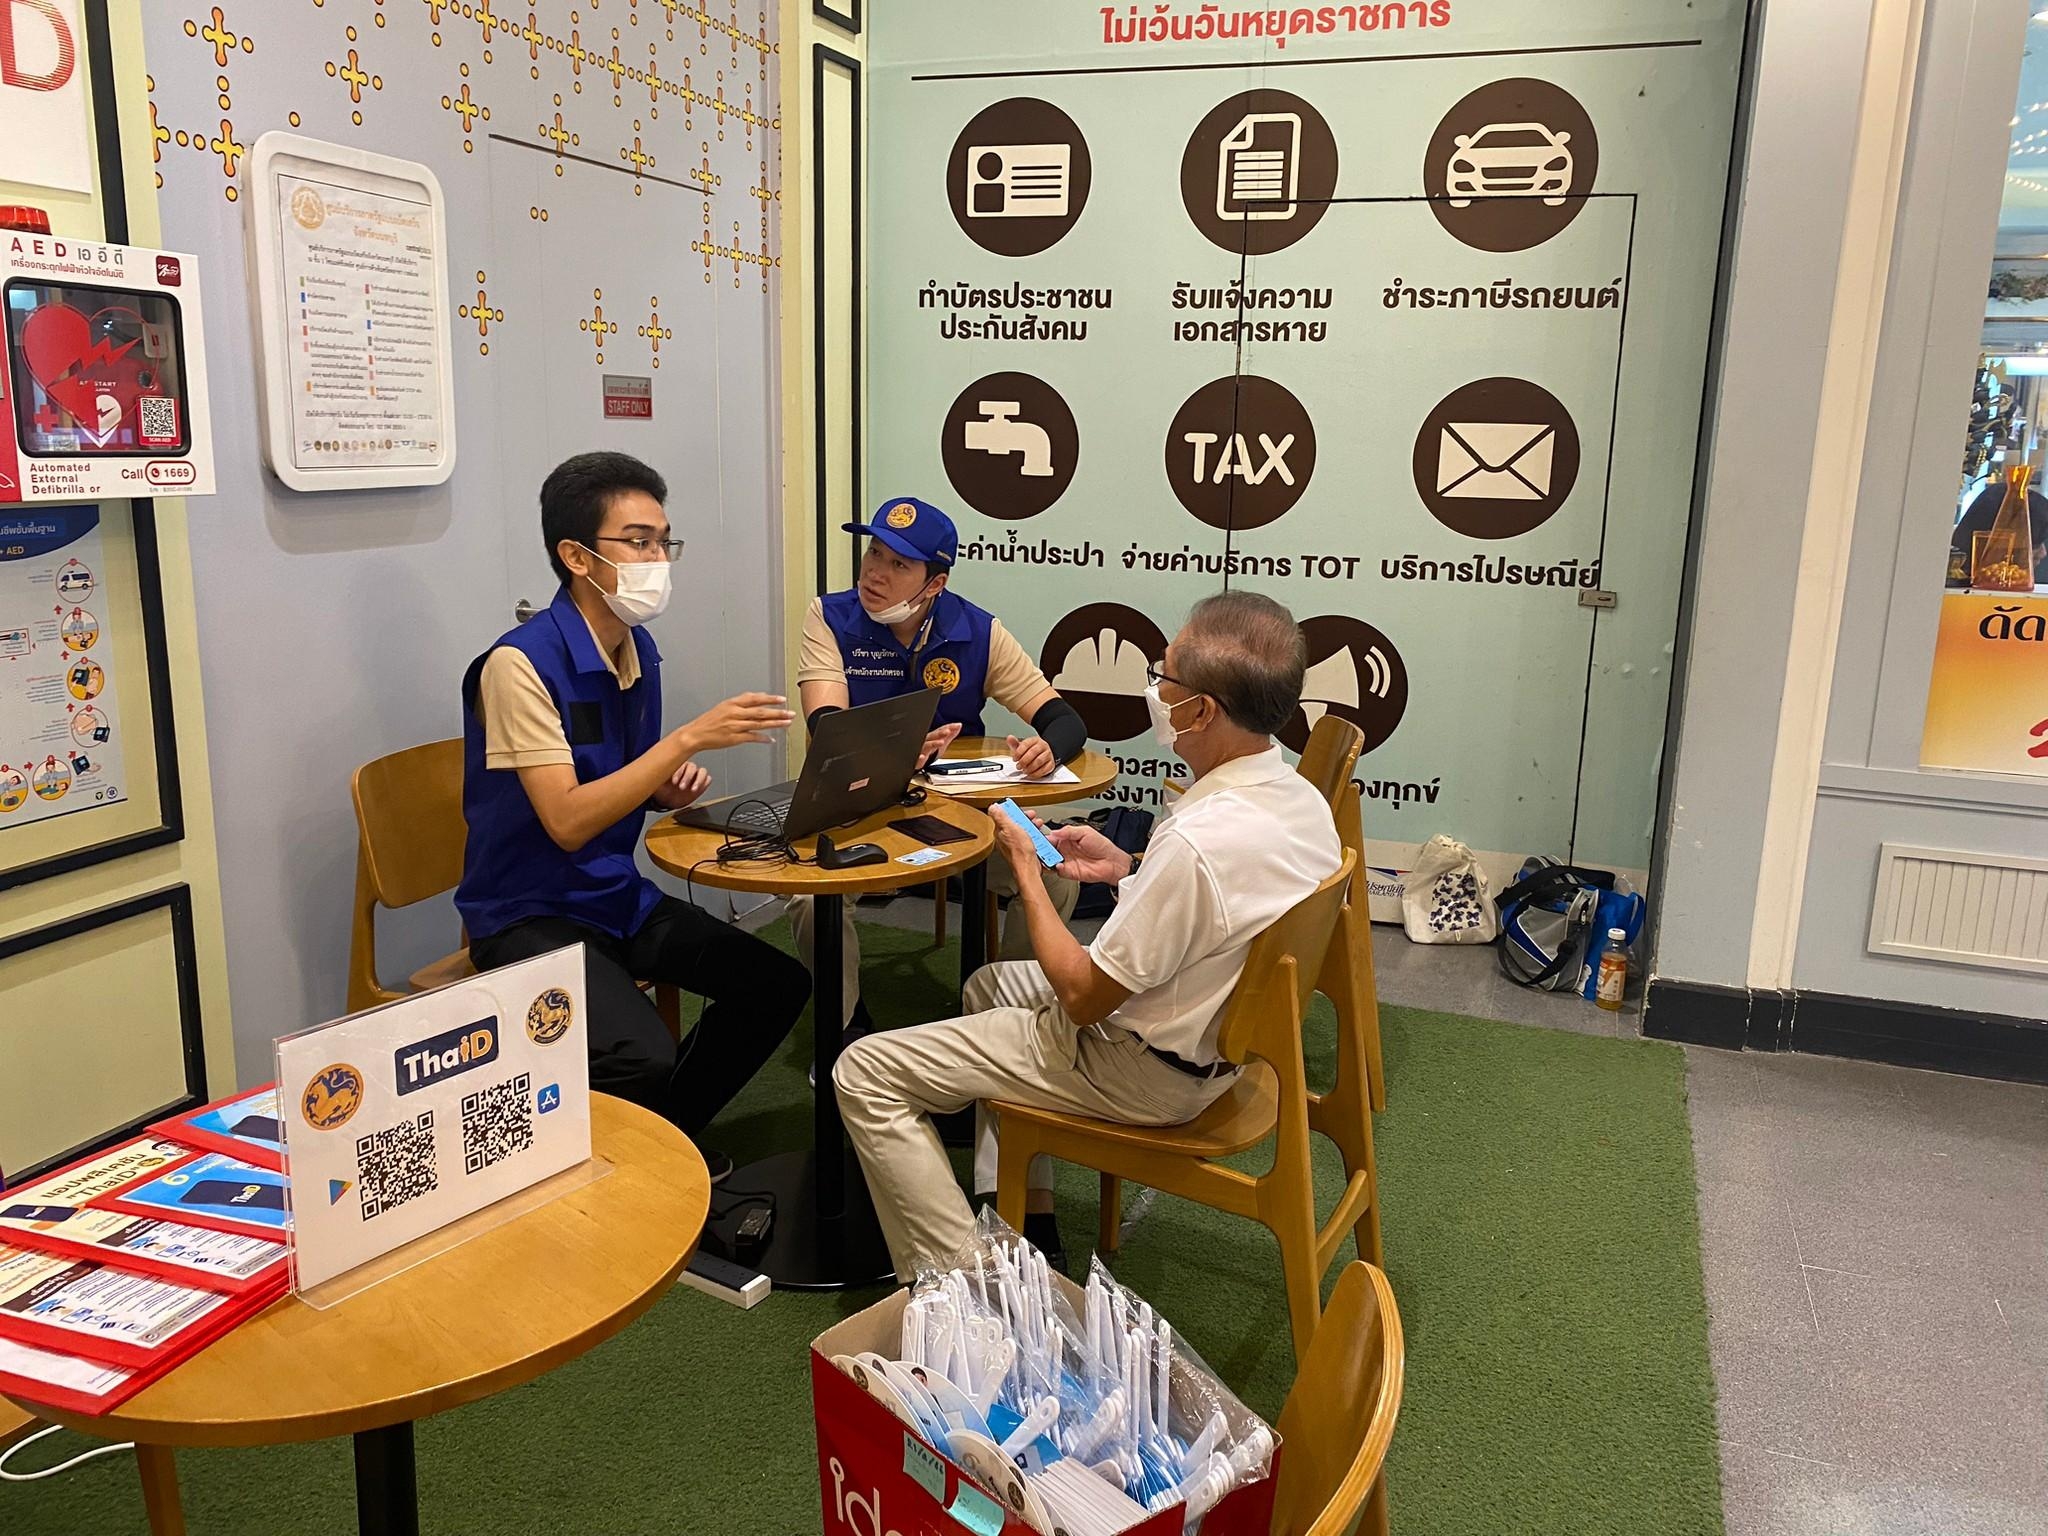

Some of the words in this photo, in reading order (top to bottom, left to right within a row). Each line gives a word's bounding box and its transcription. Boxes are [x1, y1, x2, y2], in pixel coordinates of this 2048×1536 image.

[1100, 0, 1452, 49] ไม่เว้นวันหยุดราชการ
[918, 280, 1112, 309] ทำบัตรประชาชน
[1171, 280, 1333, 310] รับแจ้งความ
[1382, 277, 1622, 309] ชำระภาษีรถยนต์
[940, 313, 1088, 341] ประกันสังคม
[1173, 318, 1327, 342] เอกสารหาย
[607, 399, 630, 414] STAFF
[631, 400, 649, 415] ONLY
[30, 463, 91, 472] Automated
[121, 469, 143, 479] Call
[164, 468, 190, 478] 1669
[1184, 432, 1295, 486] TAX
[31, 474, 78, 483] External
[1121, 542, 1292, 577] จ่ายค่าบริการ
[1301, 555, 1361, 580] TOT
[1381, 554, 1600, 588] บริการไปรษณีย์
[403, 1029, 494, 1083] ThaiD
[41, 1153, 147, 1199] แอปพลิเคชัน
